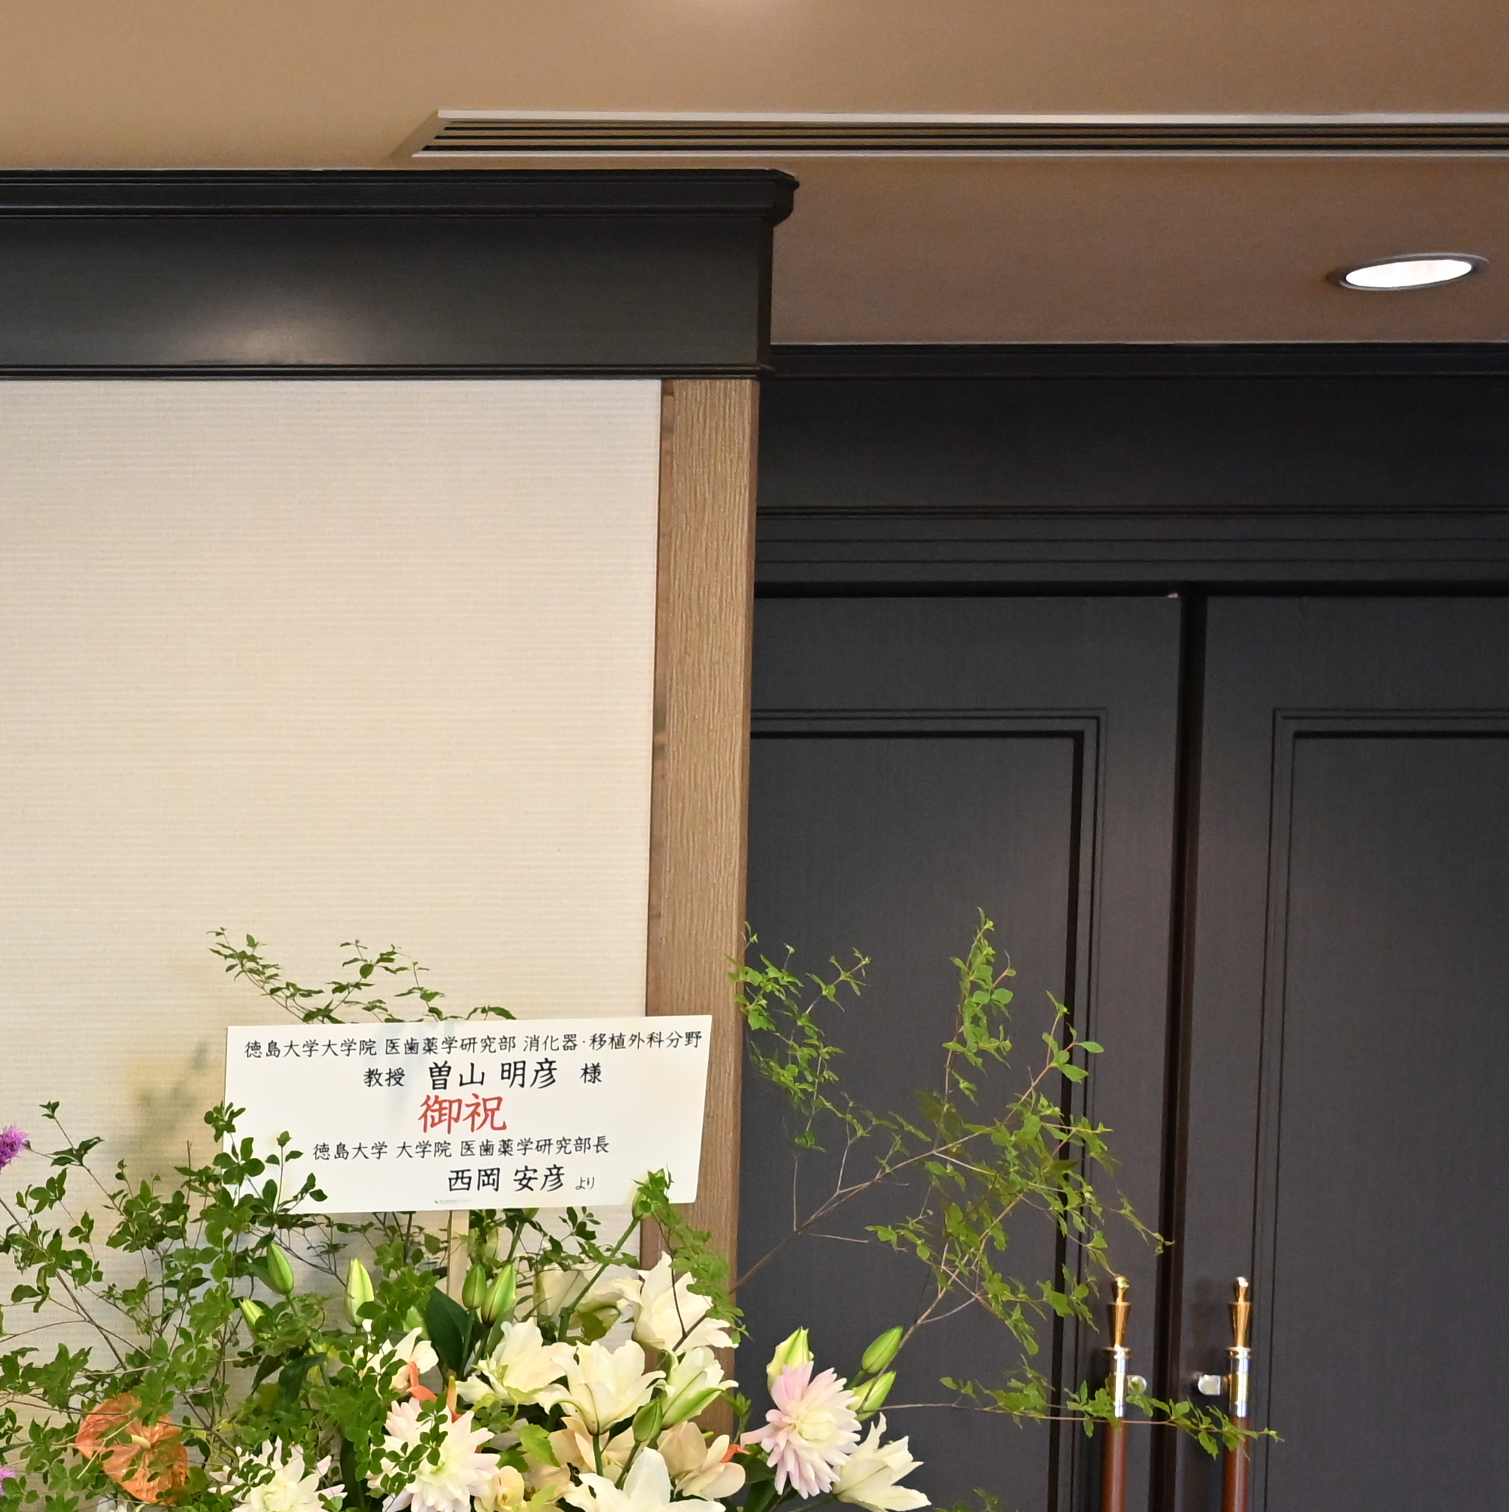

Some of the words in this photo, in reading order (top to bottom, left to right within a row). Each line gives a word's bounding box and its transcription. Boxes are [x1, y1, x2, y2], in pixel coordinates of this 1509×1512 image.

[244, 1038, 378, 1059] 徳島大学大学院
[385, 1034, 516, 1055] 医歯薬学研究部
[363, 1066, 406, 1088] 教授
[428, 1060, 486, 1091] 曽山
[500, 1057, 558, 1089] 明彦
[580, 1062, 602, 1085] 様
[417, 1092, 508, 1135] 御祝
[313, 1141, 388, 1161] 徳島大学
[396, 1140, 453, 1159] 大学院
[460, 1135, 610, 1157] 医歯薬学研究部長
[447, 1167, 501, 1192] 西岡
[513, 1163, 565, 1192] 安彦
[575, 1176, 595, 1191] より
